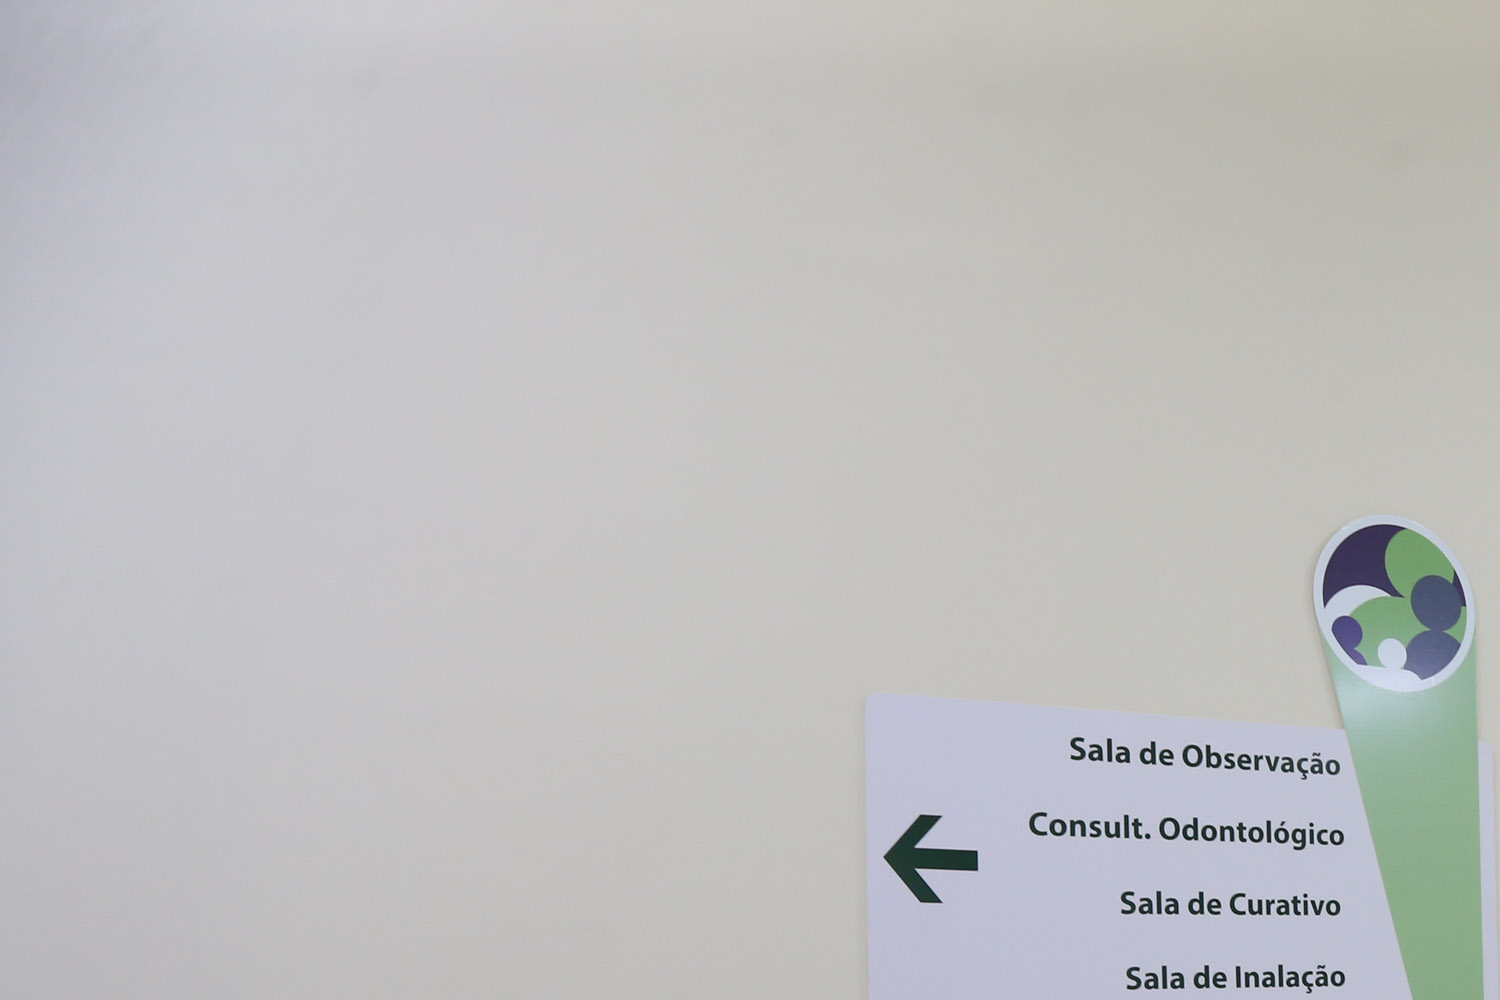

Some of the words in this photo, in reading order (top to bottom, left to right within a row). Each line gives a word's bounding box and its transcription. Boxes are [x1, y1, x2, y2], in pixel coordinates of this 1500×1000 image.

[1071, 737, 1130, 763] Sala
[1140, 741, 1174, 765] de
[1183, 745, 1340, 780] Observação
[1029, 812, 1150, 839] Consult.
[1159, 818, 1344, 850] Odontológico
[1121, 891, 1179, 914] Sala
[1188, 892, 1221, 915] de
[1230, 893, 1340, 916] Curativo
[1127, 966, 1184, 990] Sala
[1194, 965, 1227, 989] de
[1236, 965, 1345, 993] Inalação
